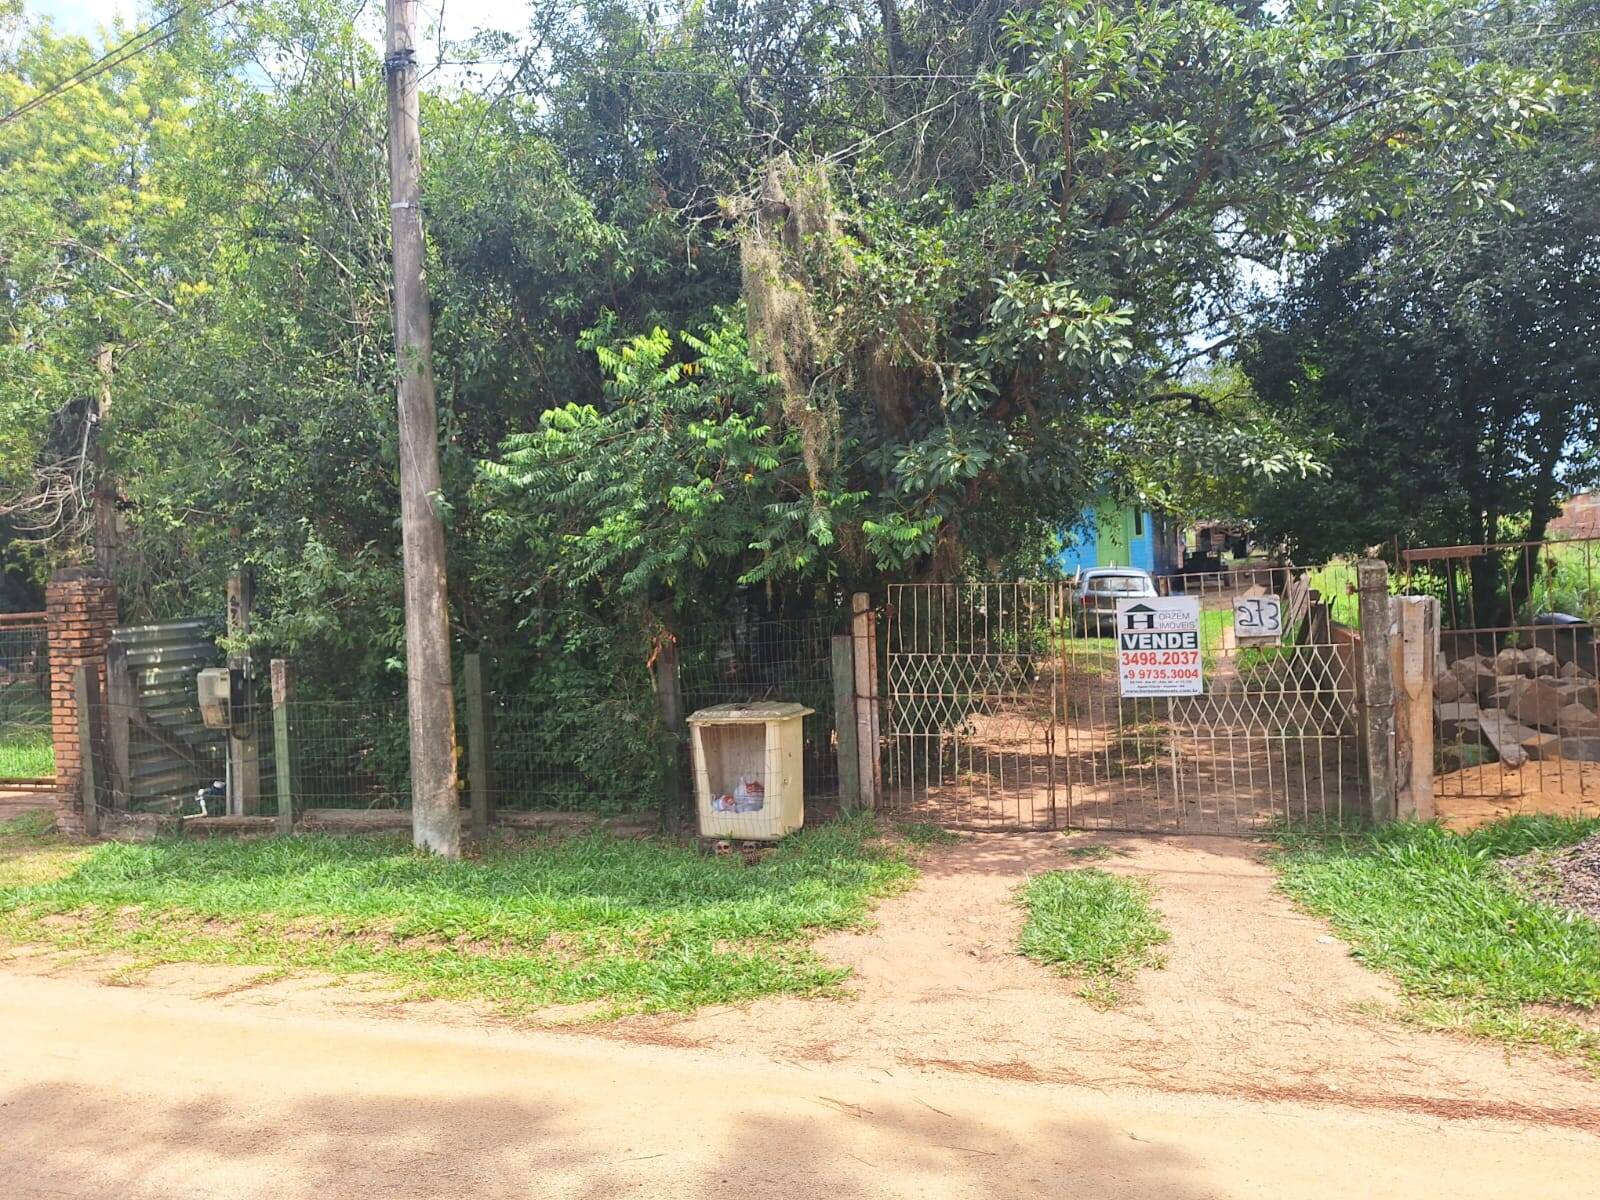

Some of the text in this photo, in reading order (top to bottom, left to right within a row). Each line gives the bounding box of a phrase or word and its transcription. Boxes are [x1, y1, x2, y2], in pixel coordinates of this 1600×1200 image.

[1237, 599, 1280, 631] 273
[1123, 633, 1196, 649] VENDE
[1122, 651, 1199, 666] 3498.2037
[1139, 668, 1199, 680] 9735.3004
